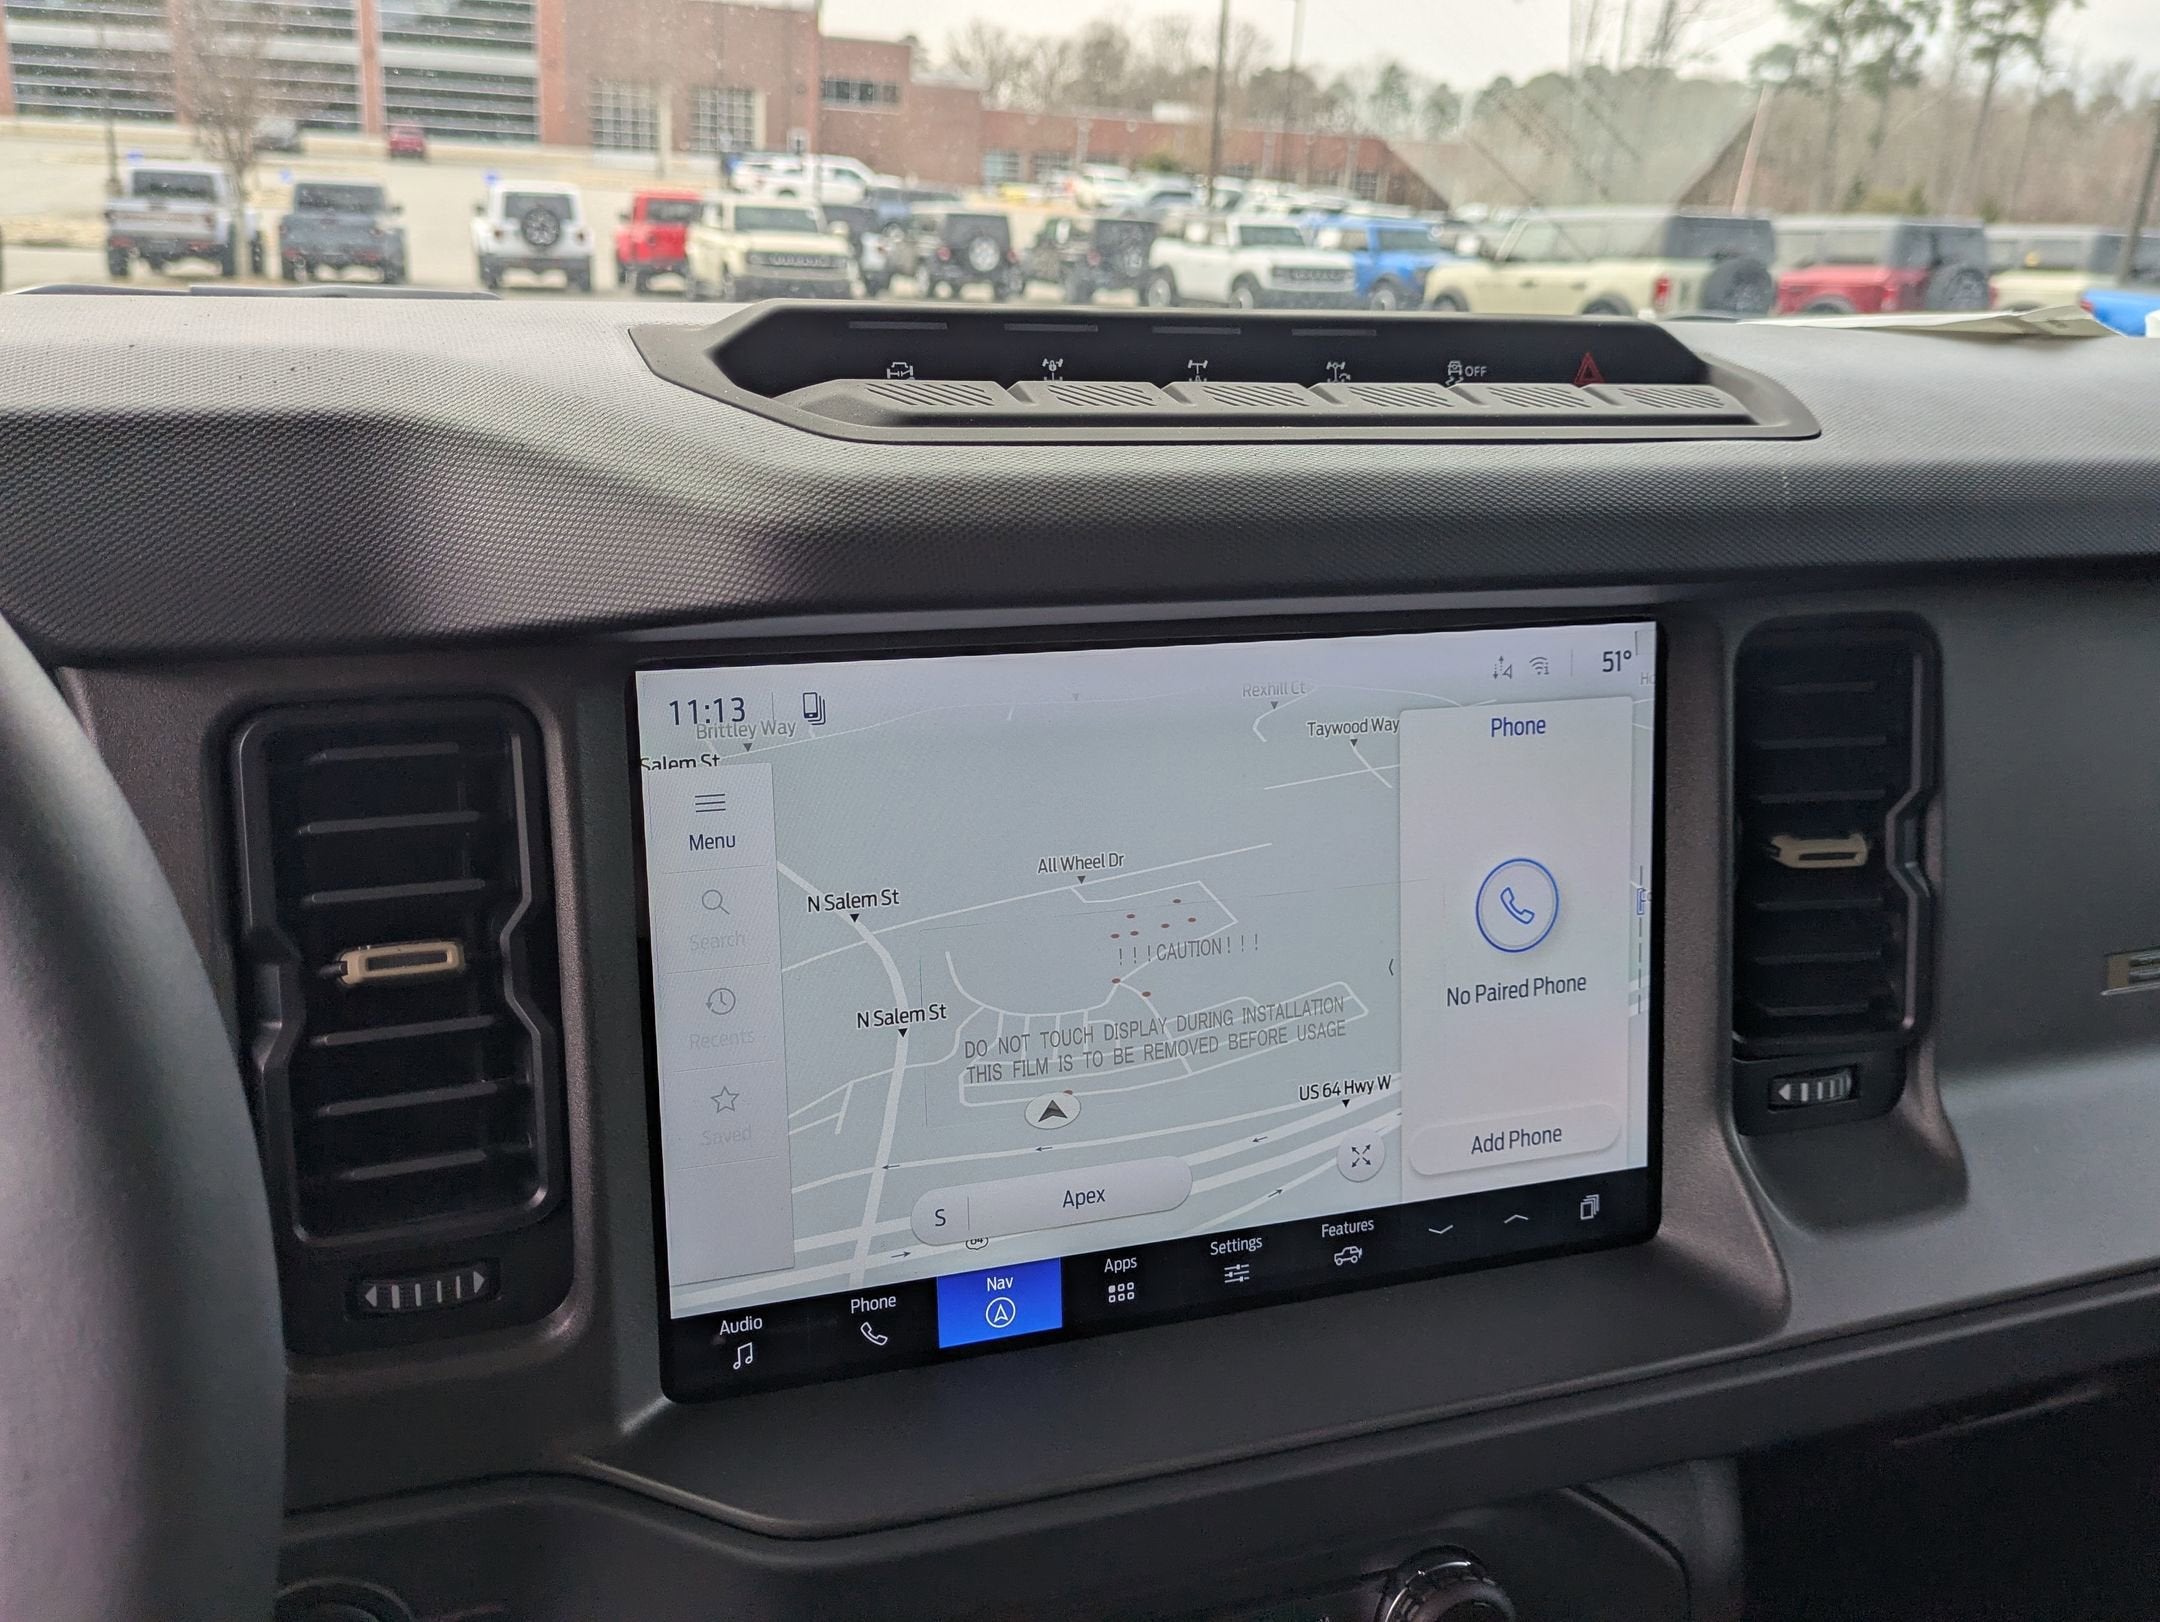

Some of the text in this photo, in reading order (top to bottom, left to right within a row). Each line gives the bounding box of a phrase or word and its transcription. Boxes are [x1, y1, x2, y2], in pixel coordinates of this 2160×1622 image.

[1465, 365, 1487, 377] OFF
[1602, 649, 1632, 673] 51°
[1242, 680, 1306, 698] Rexhill Ct
[669, 696, 746, 726] 11:13
[696, 718, 797, 740] Brittley Way
[1307, 717, 1400, 738] Taywood Way
[1491, 716, 1546, 738] Phone
[689, 833, 737, 852] Menu
[1037, 852, 1125, 874] All Wheel Dr
[807, 888, 900, 913] N Salem St
[689, 932, 746, 951] Search
[1156, 938, 1222, 961] CAUTION
[1446, 975, 1587, 1007] No Paired Phone
[857, 1003, 948, 1029] N Salem St
[964, 997, 1344, 1060] DO NOT TOUCH DISPLAY DURING INSTALLATION
[689, 1030, 757, 1050] Recents
[966, 1020, 1346, 1085] THIS FILM IS TO BE REMOVED BEFORE USAGE
[1299, 1074, 1392, 1101] US 64 Hwy W
[701, 1126, 752, 1145] Saved
[1470, 1127, 1562, 1155] Add Phone
[1062, 1187, 1107, 1209] Apex
[934, 1208, 947, 1227] S
[1321, 1217, 1375, 1239] Features
[1210, 1235, 1263, 1256] Settings
[1104, 1256, 1138, 1275] Apps
[986, 1275, 1014, 1292] Nav
[850, 1295, 897, 1314] Phone
[719, 1315, 763, 1336] Audio
